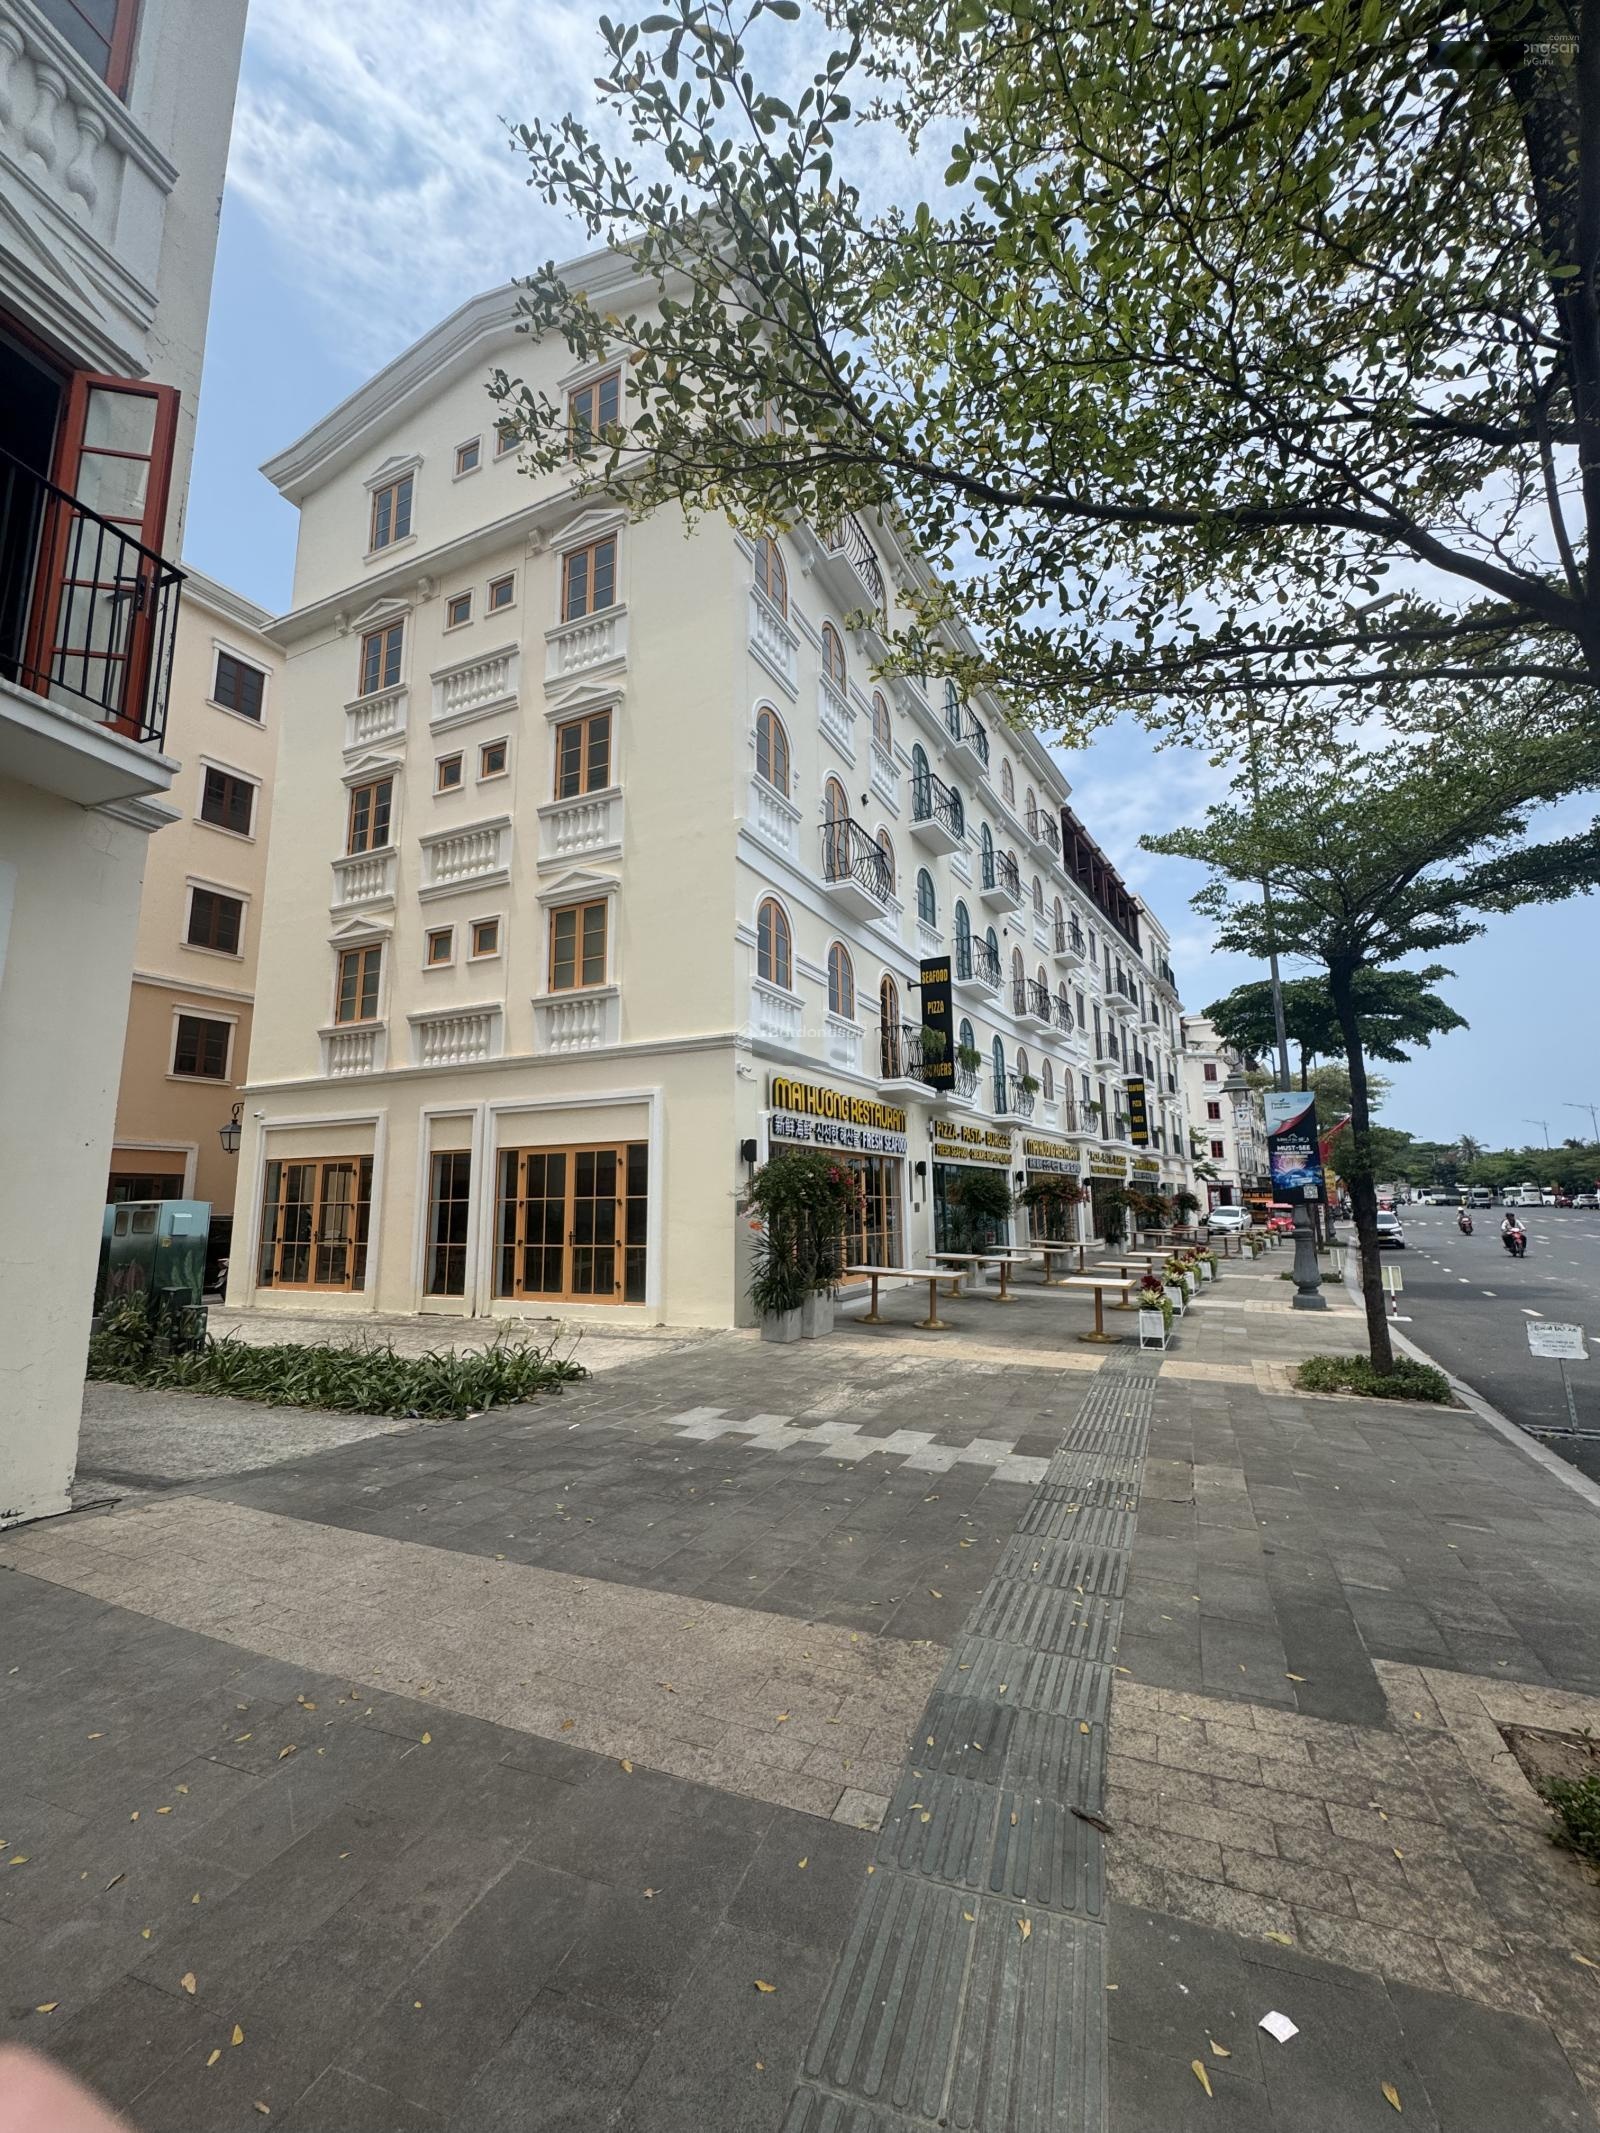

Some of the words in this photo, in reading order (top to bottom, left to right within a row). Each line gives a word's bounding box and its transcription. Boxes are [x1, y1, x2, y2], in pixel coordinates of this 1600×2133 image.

[921, 968, 948, 984] SEAFOOD
[927, 1000, 945, 1015] PIZZA
[773, 1077, 805, 1112] MAI
[849, 1096, 907, 1132] RESTAURANT
[861, 1131, 883, 1150] FRESH
[883, 1135, 908, 1153] SEAFOOD
[935, 1121, 957, 1140] PIZZA
[961, 1126, 982, 1145] PASTA
